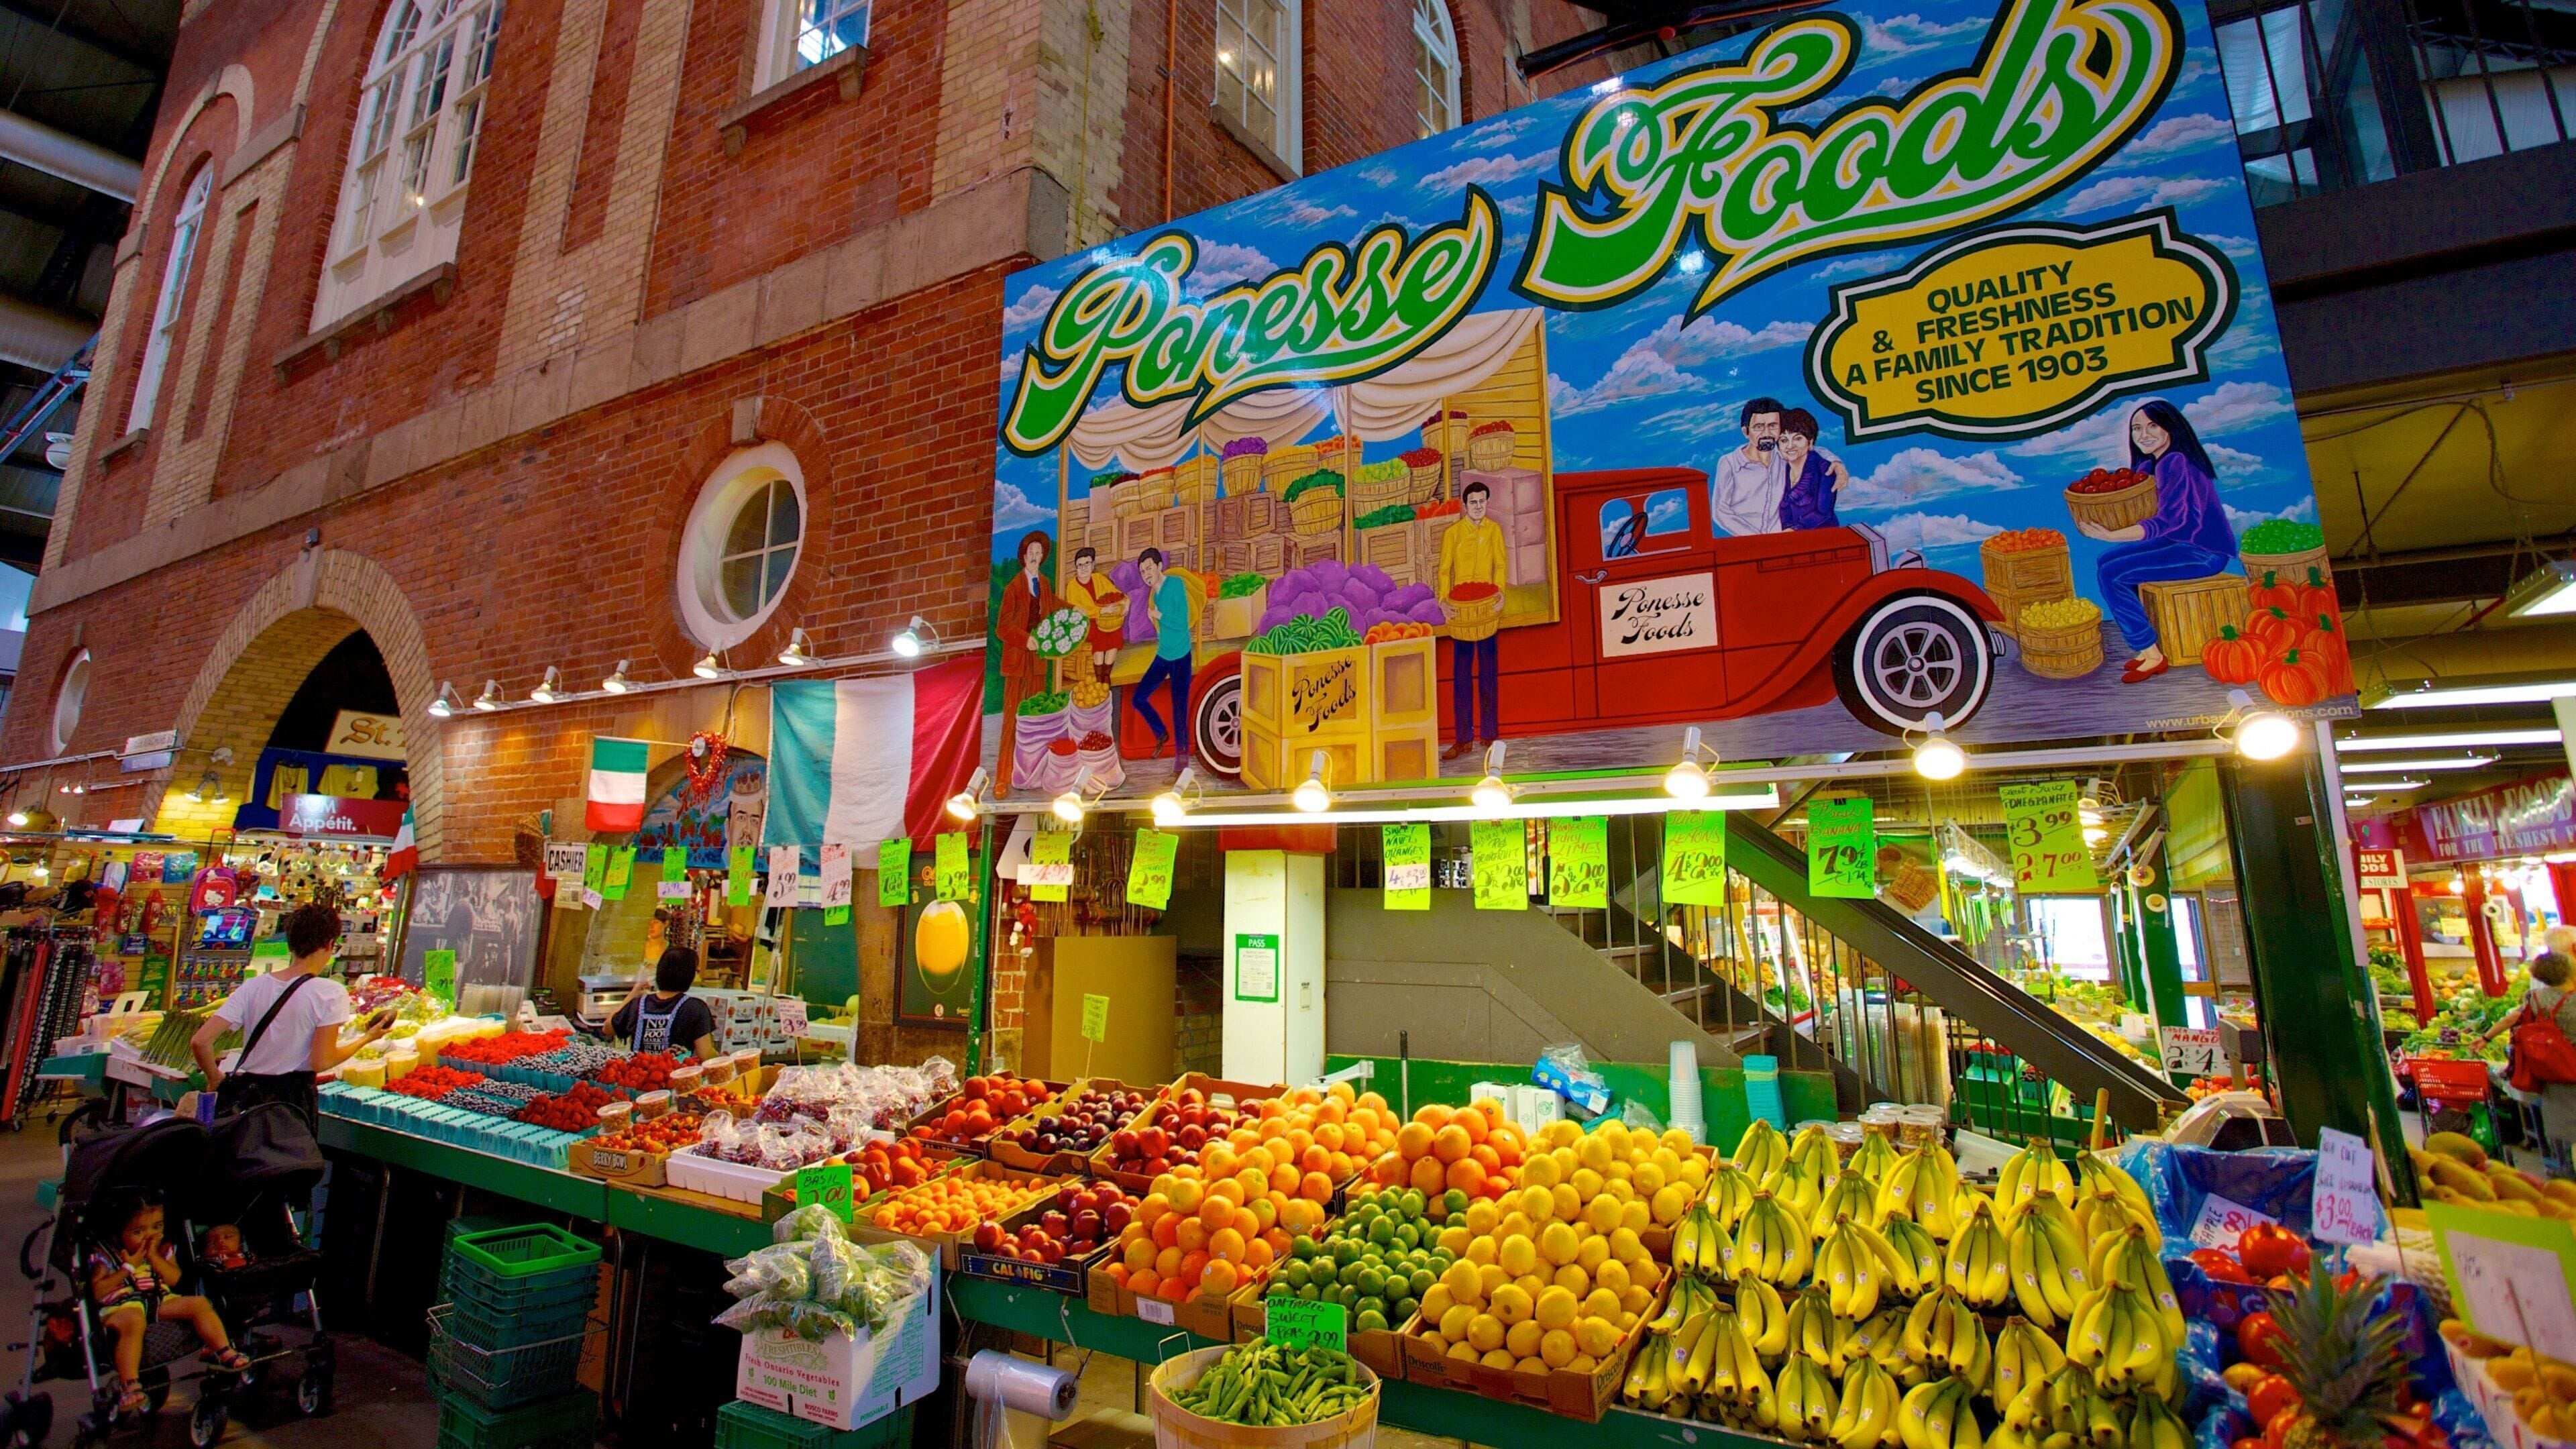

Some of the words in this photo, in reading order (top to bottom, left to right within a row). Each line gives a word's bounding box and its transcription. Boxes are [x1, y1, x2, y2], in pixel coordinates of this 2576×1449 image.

[1000, 182, 1503, 458] Ponesse
[1508, 0, 2185, 330] Foods
[1927, 260, 2074, 315] QUALITY
[1872, 329, 1894, 354] &
[1917, 282, 2116, 345] FRESHNESS
[1845, 364, 1866, 388] A
[1874, 338, 1986, 382] FAMILY
[1998, 297, 2195, 357] TRADITION
[1915, 364, 2011, 403] SINCE
[2017, 345, 2108, 384] 1903
[1611, 586, 1705, 621] Ponesse
[1621, 612, 1697, 645] Foods
[1292, 655, 1352, 715] Ponesse
[1305, 678, 1357, 733] Foods
[340, 716, 391, 747] St.
[2003, 792, 2075, 810] POMEGRANATE
[2430, 792, 2500, 841] FAMILY
[289, 813, 357, 833] Appétit.
[1668, 826, 1721, 846] LEMONS
[1809, 820, 1871, 837] BANANAS
[548, 849, 584, 873] CASHIER
[2438, 842, 2459, 857] FOR
[2462, 838, 2485, 854] THE
[1248, 938, 1266, 948] PASS
[803, 1173, 842, 1187] BASIL
[2199, 1206, 2223, 1246] EAPPLE
[992, 1261, 1015, 1277] CAL
[1022, 1266, 1044, 1281] FIG
[1267, 1310, 1318, 1328] SWEET
[763, 1341, 818, 1356] FRESHTIBLES
[745, 1353, 761, 1368] Fresh
[764, 1360, 795, 1377] Ontario
[797, 1369, 841, 1387] Vegetables
[763, 1374, 778, 1387] 100
[779, 1379, 798, 1393] Mile
[799, 1384, 818, 1399] Diet
